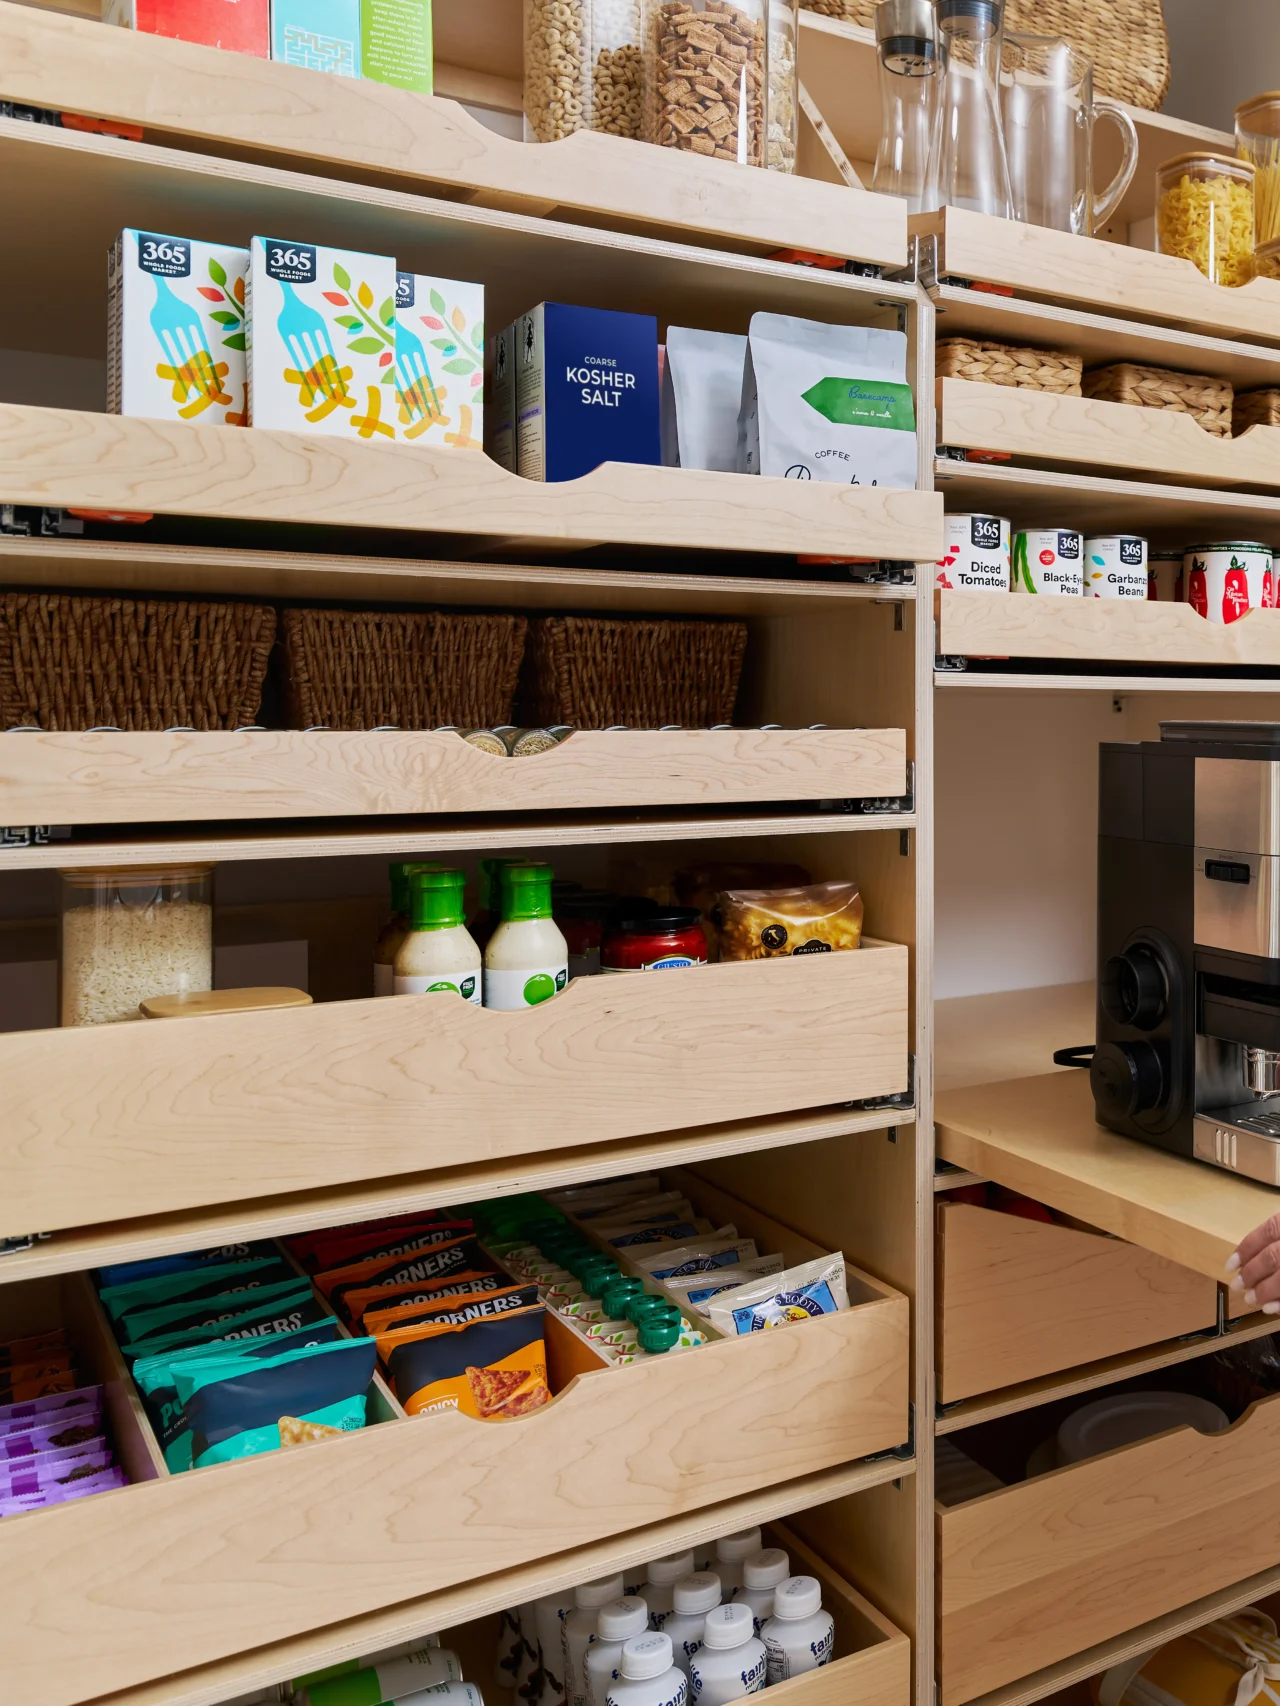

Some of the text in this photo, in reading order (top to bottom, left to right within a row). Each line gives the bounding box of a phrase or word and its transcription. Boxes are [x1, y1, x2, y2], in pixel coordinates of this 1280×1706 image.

[142, 241, 186, 265] 365
[270, 248, 312, 270] 365
[142, 261, 186, 272] WHOLE FOODS
[584, 356, 617, 367] COARSE
[566, 366, 636, 389] KOSHER
[581, 388, 622, 407] SALT
[848, 385, 896, 409] Basecamp
[814, 449, 851, 462] COFFEE
[974, 521, 999, 538] 365
[1060, 537, 1078, 550] 365
[1122, 543, 1141, 557] 365
[971, 561, 1001, 575] Diced
[958, 573, 1007, 588] Tomatoes
[1107, 573, 1147, 585] Garbanz
[1060, 584, 1079, 595] Peas
[1118, 585, 1144, 597] Beans
[785, 1294, 819, 1313] BOOTY
[163, 1428, 173, 1438] THE
